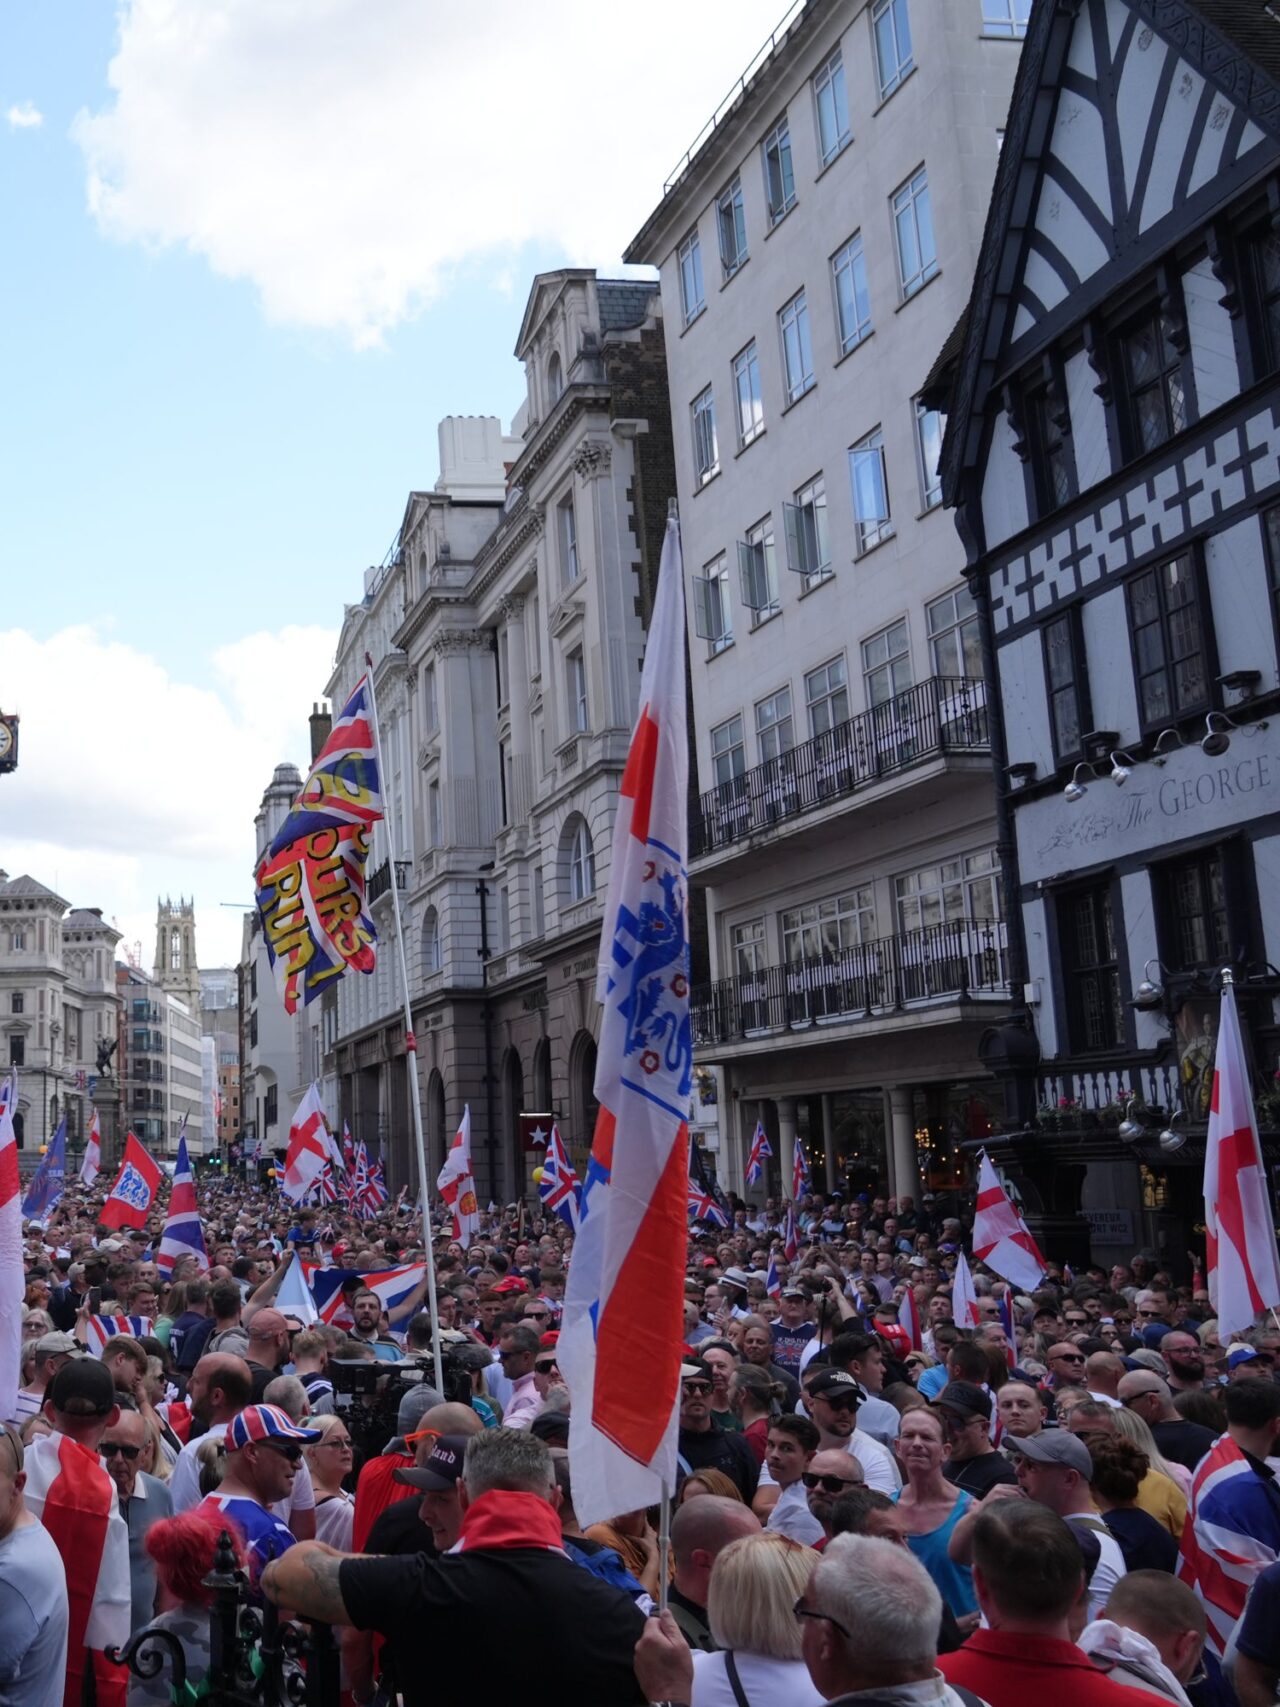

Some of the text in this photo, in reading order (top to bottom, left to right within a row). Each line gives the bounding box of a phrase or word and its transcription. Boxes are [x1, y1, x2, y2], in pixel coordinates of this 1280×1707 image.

[1117, 754, 1272, 833] The GEORGE
[428, 1444, 456, 1465] land
